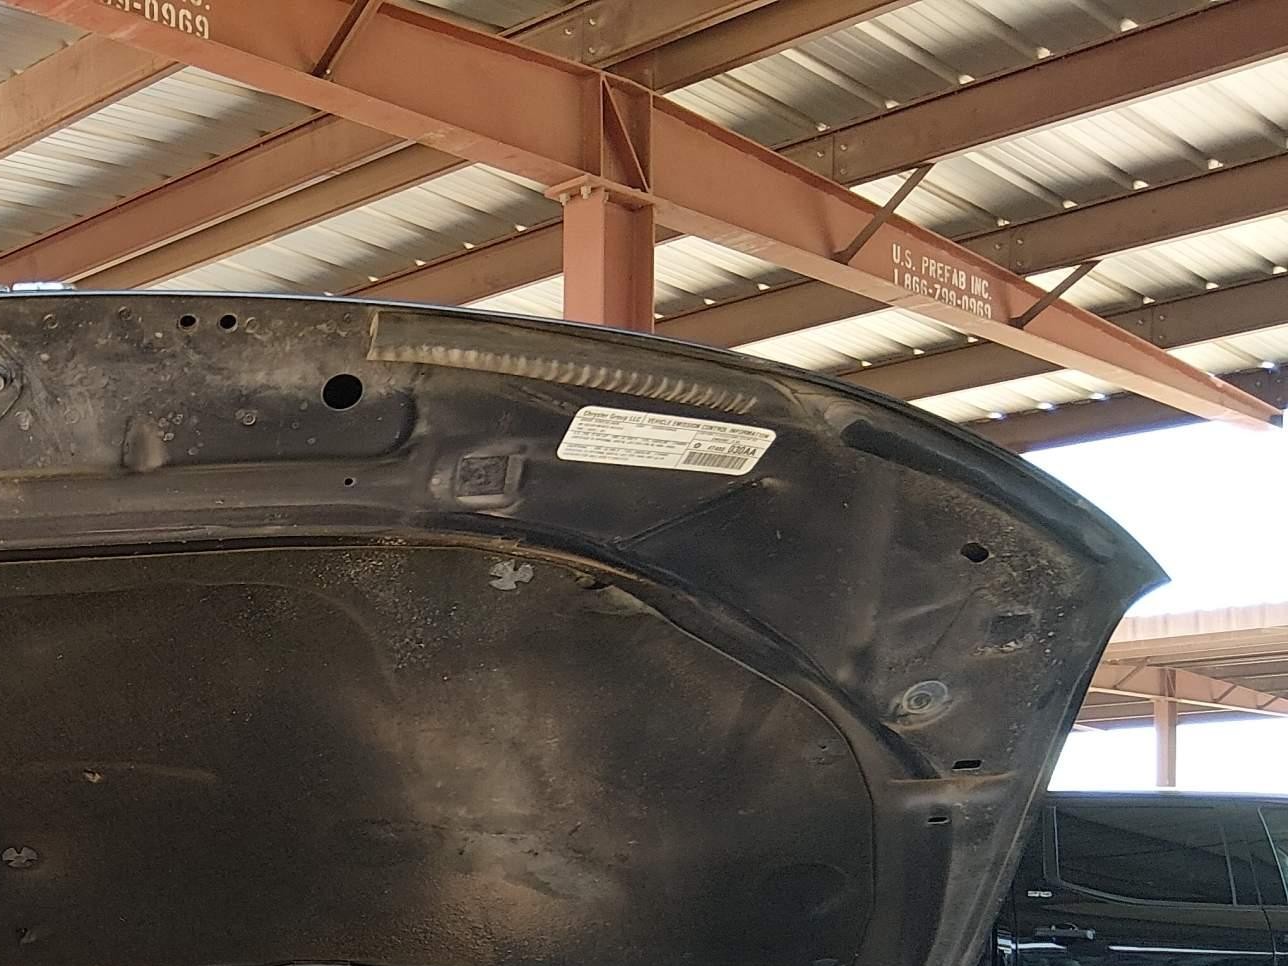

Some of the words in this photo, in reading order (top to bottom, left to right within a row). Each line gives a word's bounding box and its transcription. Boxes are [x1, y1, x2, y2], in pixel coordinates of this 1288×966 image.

[892, 244, 916, 271] U.S.
[922, 257, 967, 290] PREFAB
[971, 275, 992, 300] INC.
[701, 423, 727, 432] CONTROL
[729, 427, 770, 439] INFORMATION
